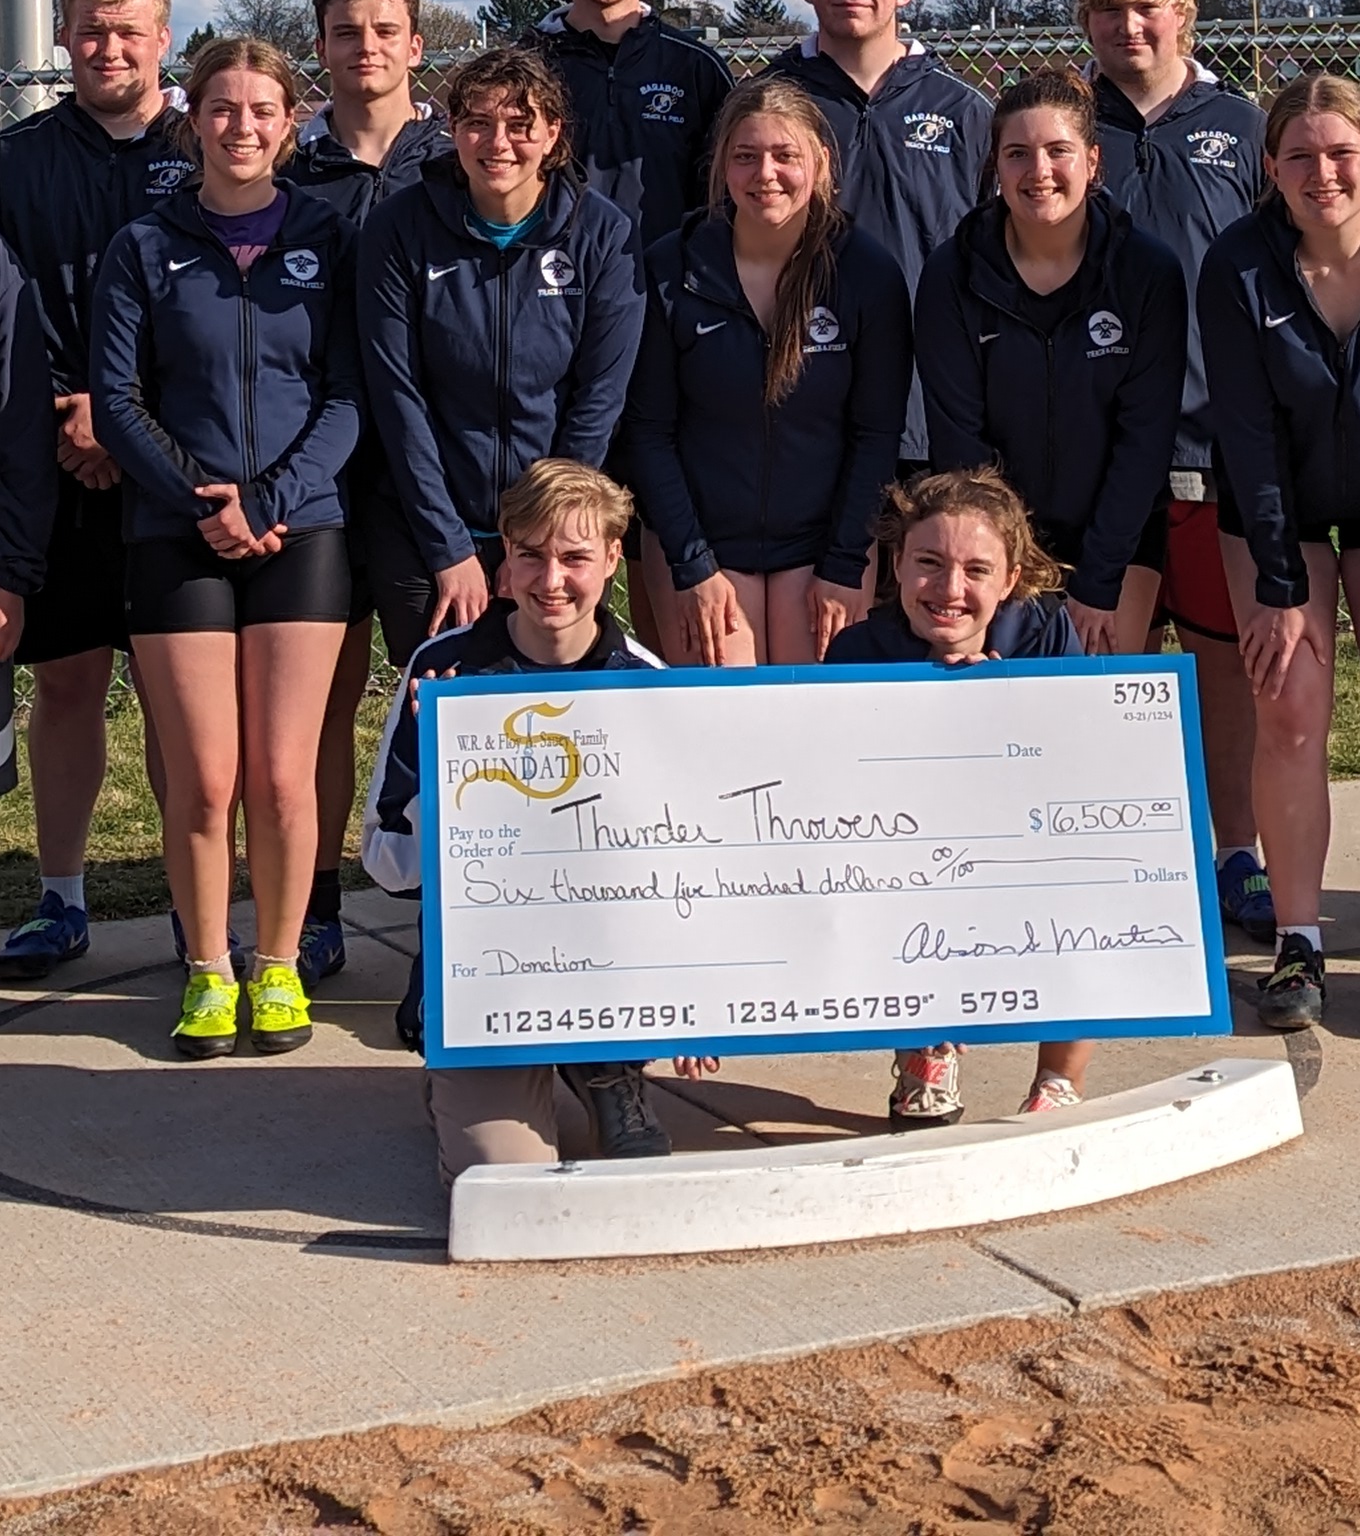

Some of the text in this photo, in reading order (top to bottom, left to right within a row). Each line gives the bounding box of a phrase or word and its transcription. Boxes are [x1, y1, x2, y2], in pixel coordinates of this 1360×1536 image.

[640, 83, 684, 97] BARABOO
[904, 113, 954, 128] BARABOO
[1186, 131, 1238, 144] BARABOO
[1113, 681, 1171, 705] 5793
[1123, 711, 1173, 721] 43-21/1234
[456, 734, 481, 751] W.R.
[484, 735, 495, 750] &
[573, 729, 609, 751] Family
[1006, 742, 1042, 758] Date
[446, 752, 621, 784] FOUNDATION
[1028, 807, 1043, 833] $
[449, 824, 521, 844] Pay to the
[449, 841, 516, 858] Order of
[1133, 868, 1189, 883] Dollars
[463, 859, 544, 905] Six
[550, 868, 665, 903] thousand
[668, 871, 713, 919] five
[715, 867, 812, 896] hundred
[819, 864, 904, 896] dollars
[482, 946, 614, 976] Donation
[451, 963, 478, 978] For
[960, 989, 1039, 1015] 5793
